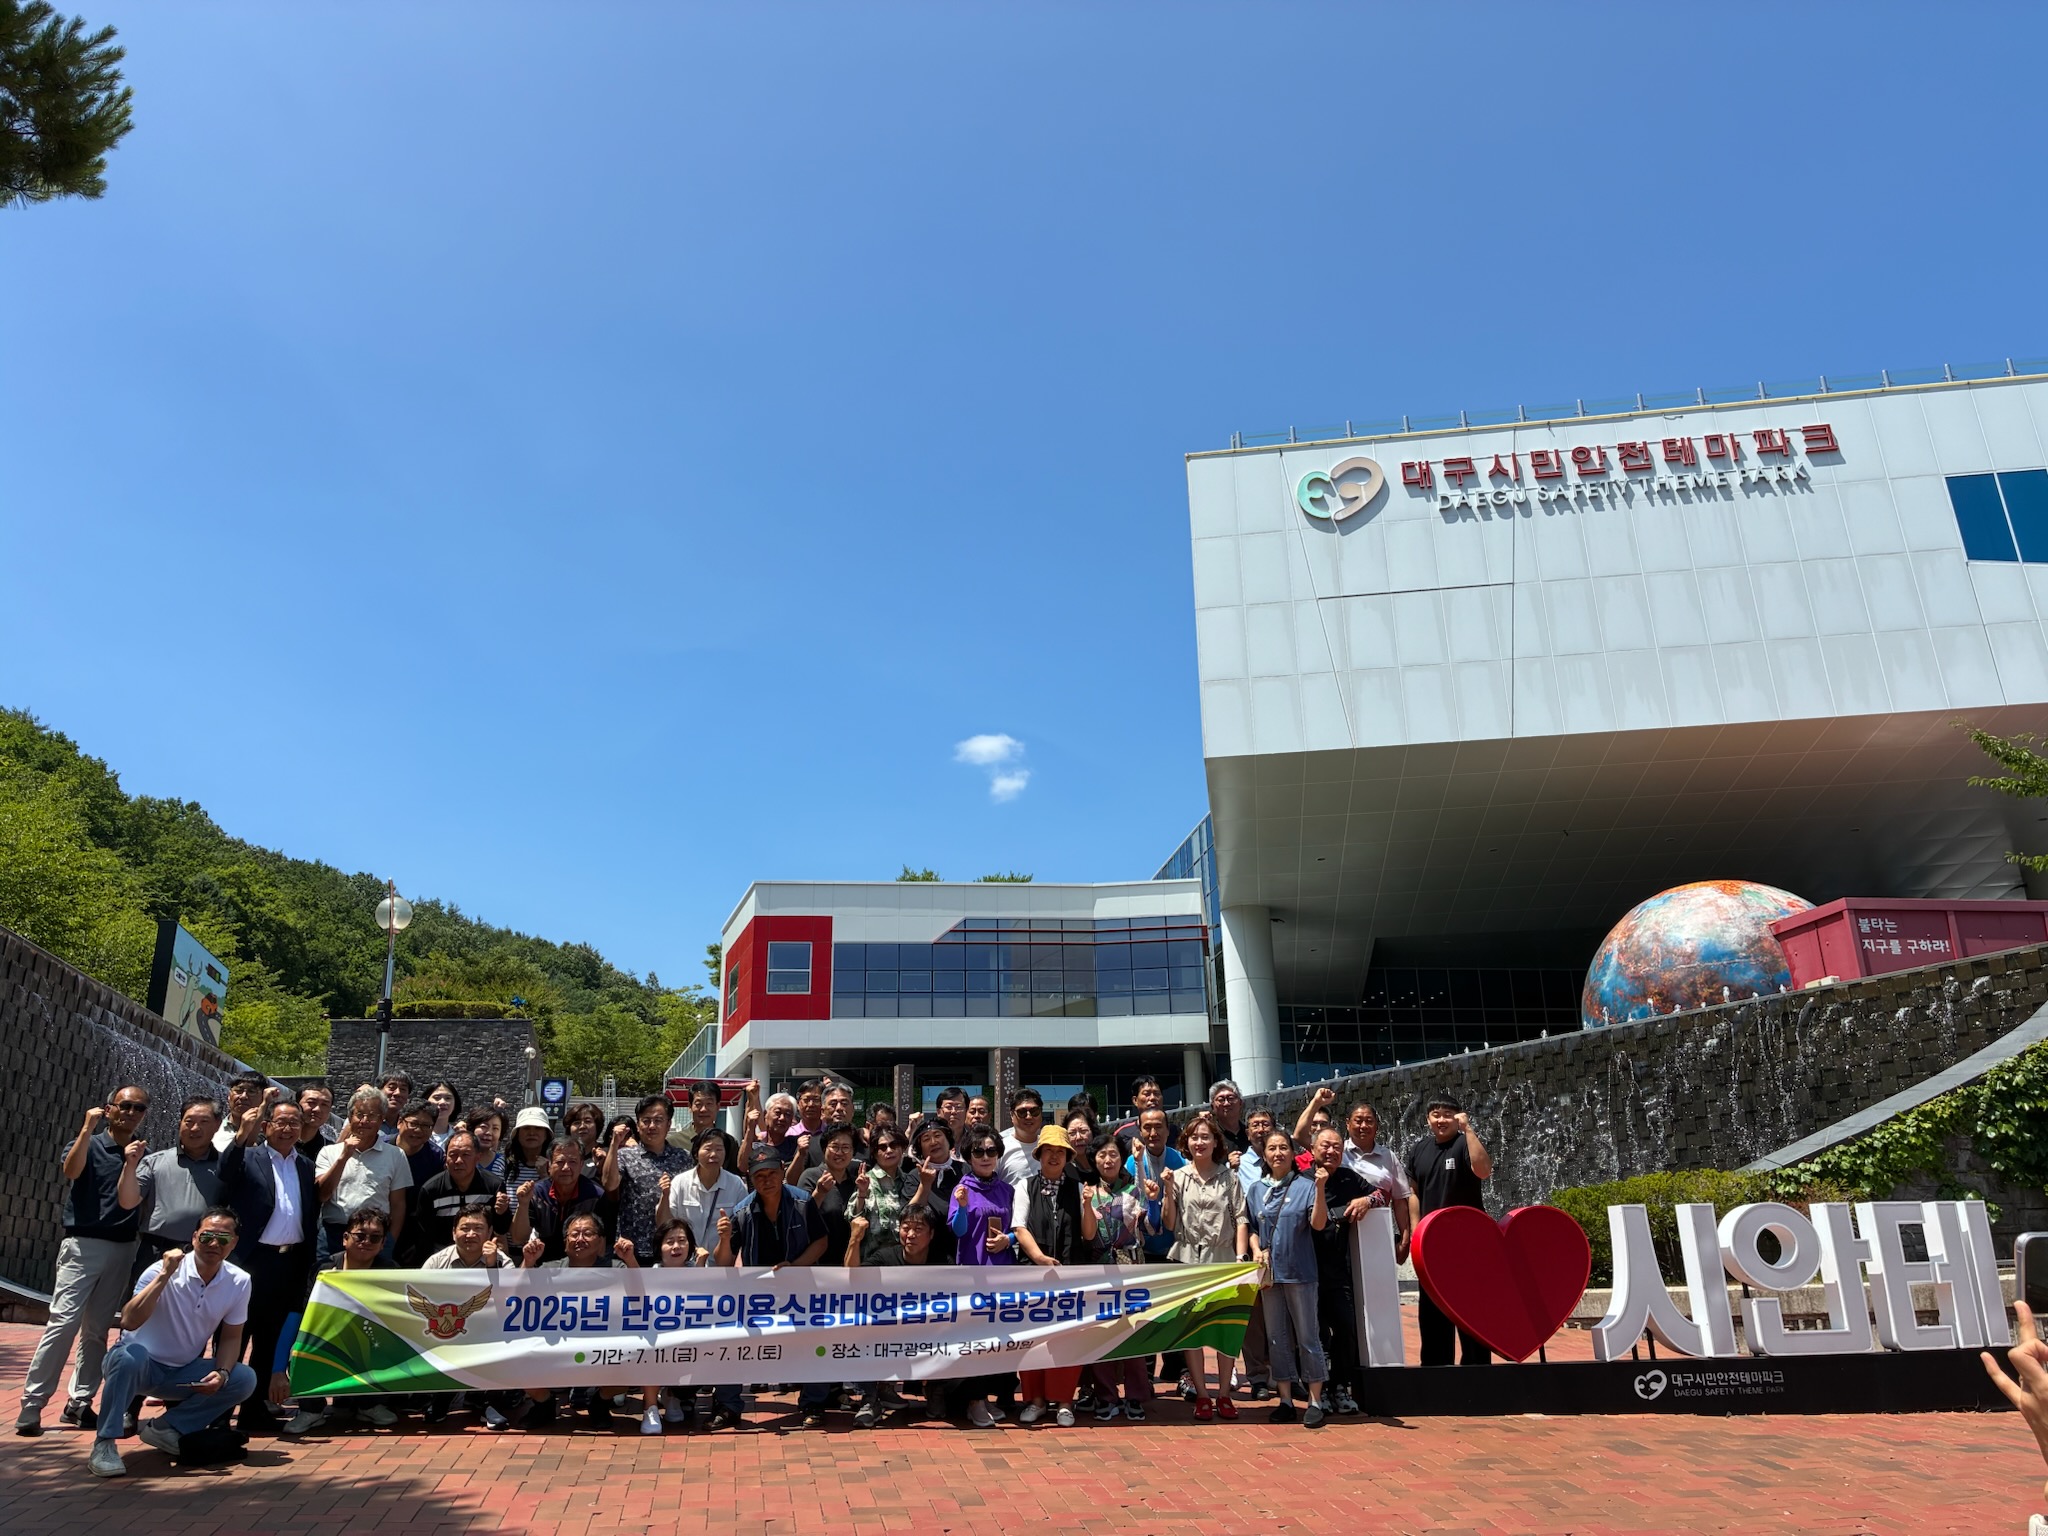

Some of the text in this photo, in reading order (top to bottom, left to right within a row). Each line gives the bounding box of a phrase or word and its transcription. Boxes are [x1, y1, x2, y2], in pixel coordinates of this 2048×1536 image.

[1401, 424, 1840, 488] 대구시민안전테마파크
[1439, 462, 1807, 511] DAEGU SAFETY THEME PARK
[1858, 918, 1898, 933] 불타는
[1862, 939, 1950, 955] 지구를 구하라!
[1592, 1200, 2013, 1361] 시안테
[503, 1288, 1152, 1332] 2025년 단양군의용소방대연합회 역량강화 교육
[591, 1349, 623, 1365] 기간
[636, 1349, 647, 1364] 7.
[719, 1347, 730, 1361] 7.
[832, 1343, 861, 1359] 장소
[874, 1342, 951, 1357] 대구광역시,
[958, 1341, 1001, 1356] 경주시
[1671, 1370, 1785, 1387] 대구시민안전테마파크
[1674, 1388, 1702, 1397] DAEGU
[1705, 1387, 1735, 1396] SAFETY
[1738, 1386, 1764, 1395] THEME
